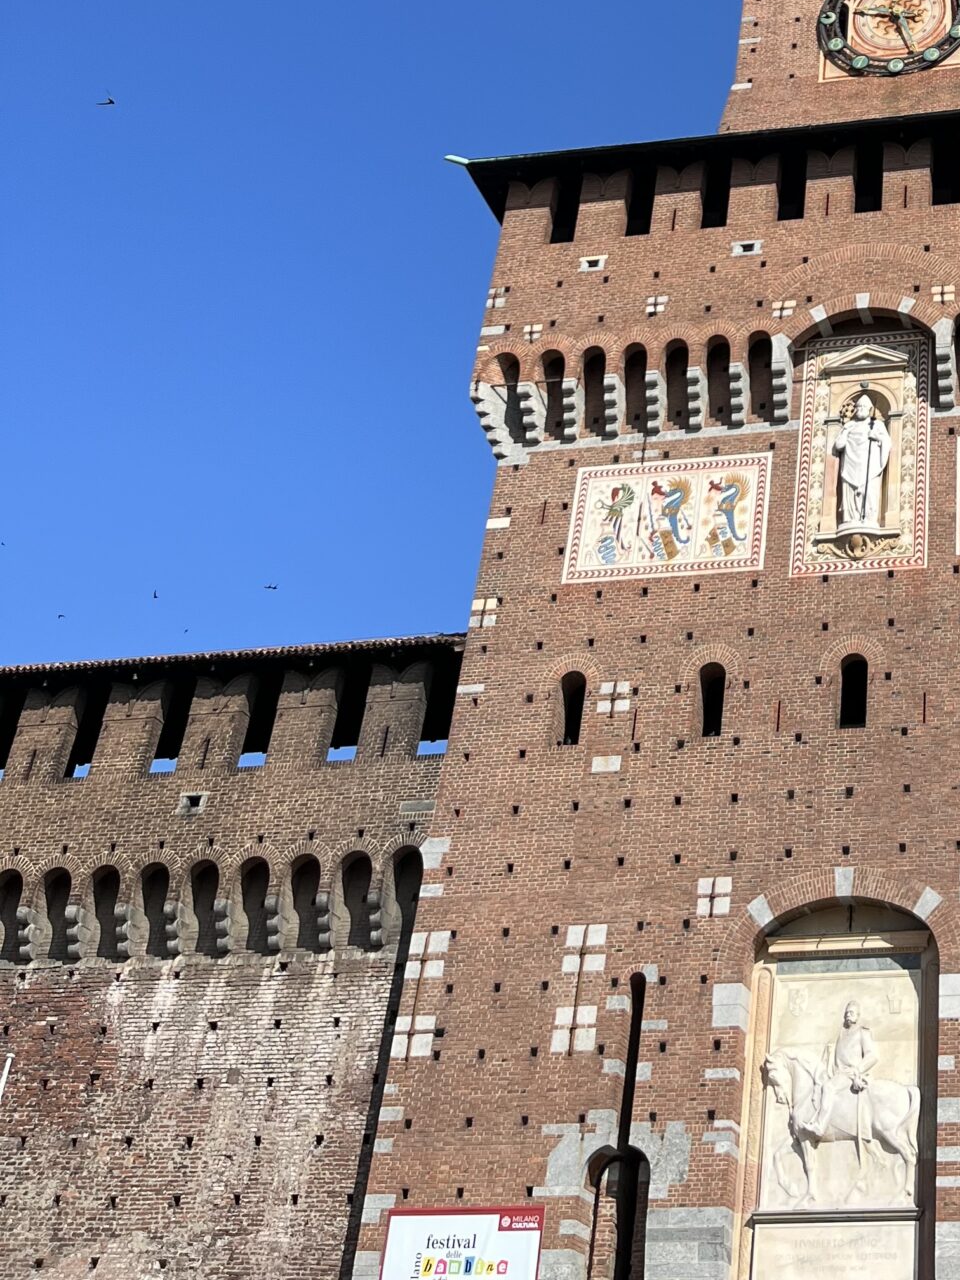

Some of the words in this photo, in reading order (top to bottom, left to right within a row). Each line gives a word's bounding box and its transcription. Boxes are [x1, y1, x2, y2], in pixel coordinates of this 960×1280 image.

[426, 1234, 477, 1249] festival
[446, 1250, 462, 1259] delle
[421, 1256, 508, 1276] bambine
